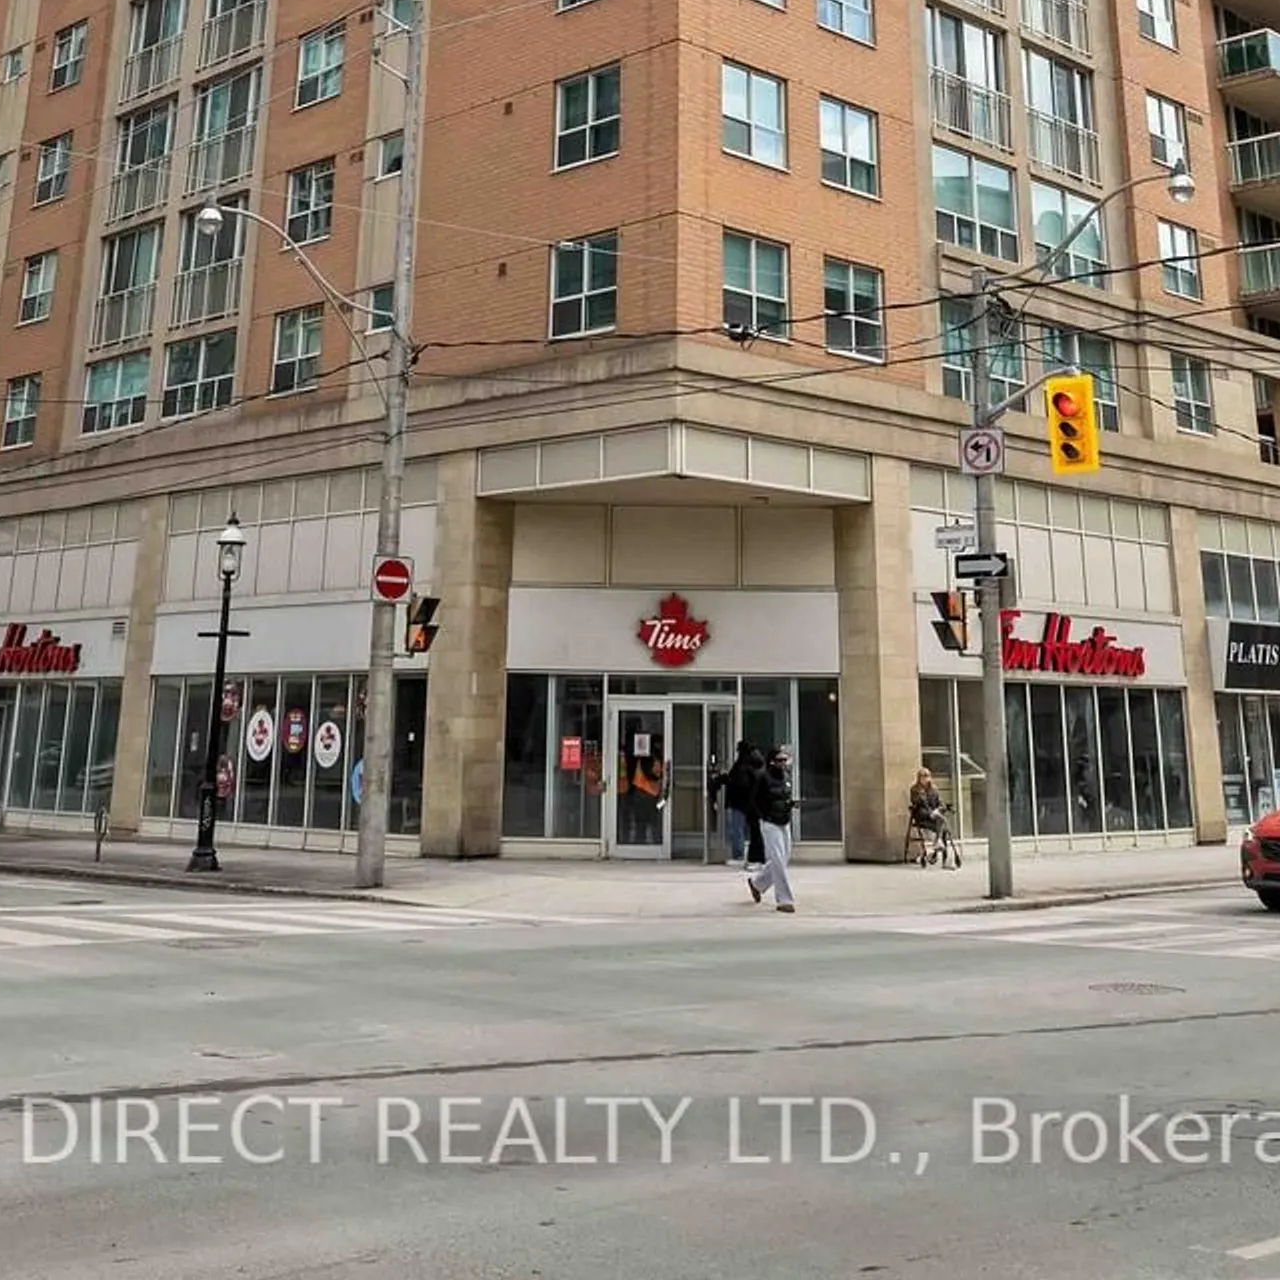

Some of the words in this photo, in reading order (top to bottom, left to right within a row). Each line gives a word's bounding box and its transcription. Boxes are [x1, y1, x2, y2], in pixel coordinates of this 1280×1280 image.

[0, 622, 83, 674] Hortons
[645, 619, 702, 650] Tims
[1039, 612, 1146, 677] Hortons
[1229, 641, 1279, 666] PLATIS
